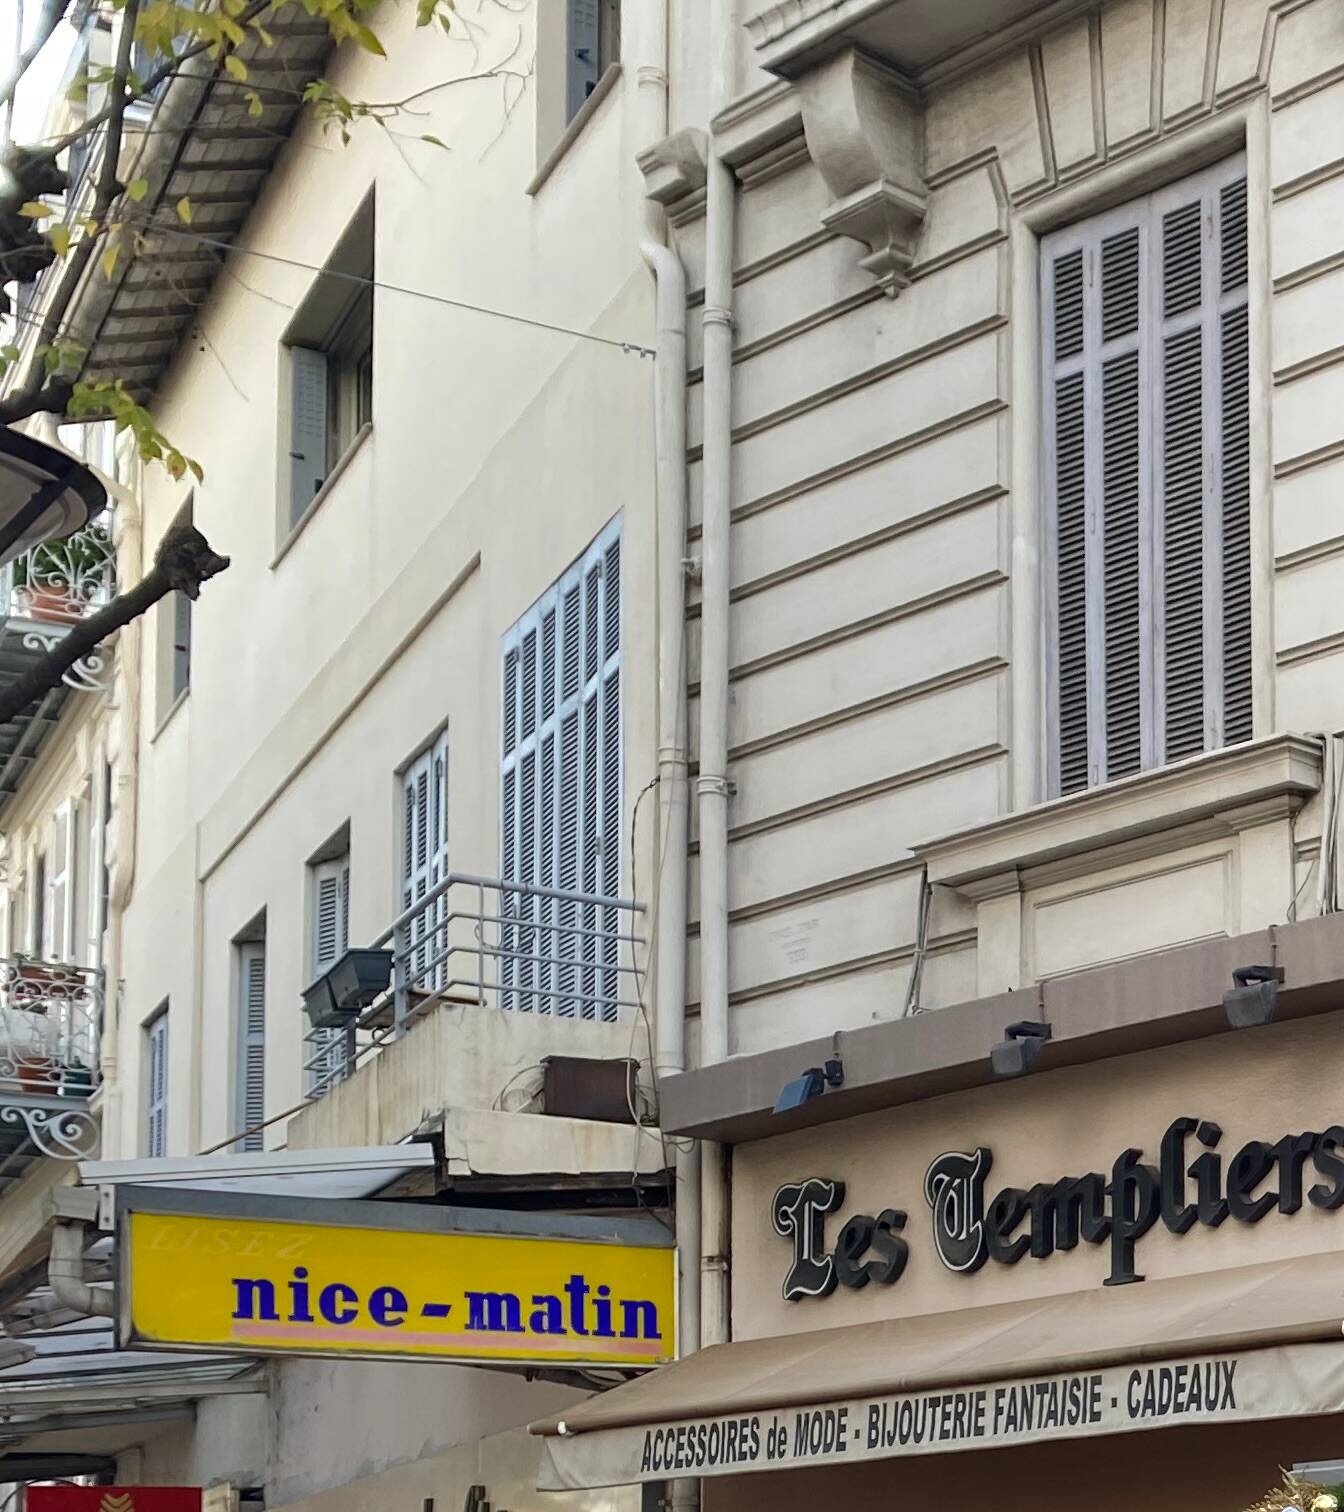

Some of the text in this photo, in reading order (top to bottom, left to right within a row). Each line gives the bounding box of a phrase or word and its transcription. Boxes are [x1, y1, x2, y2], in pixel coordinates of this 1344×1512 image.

[150, 1224, 314, 1258] LISEZ
[772, 1178, 909, 1301] Les
[231, 1266, 662, 1339] nice-matin
[641, 1360, 1237, 1473] ACCESSOIRES de MODE BIJOUTERIE FANTAISIE CADEAUX
